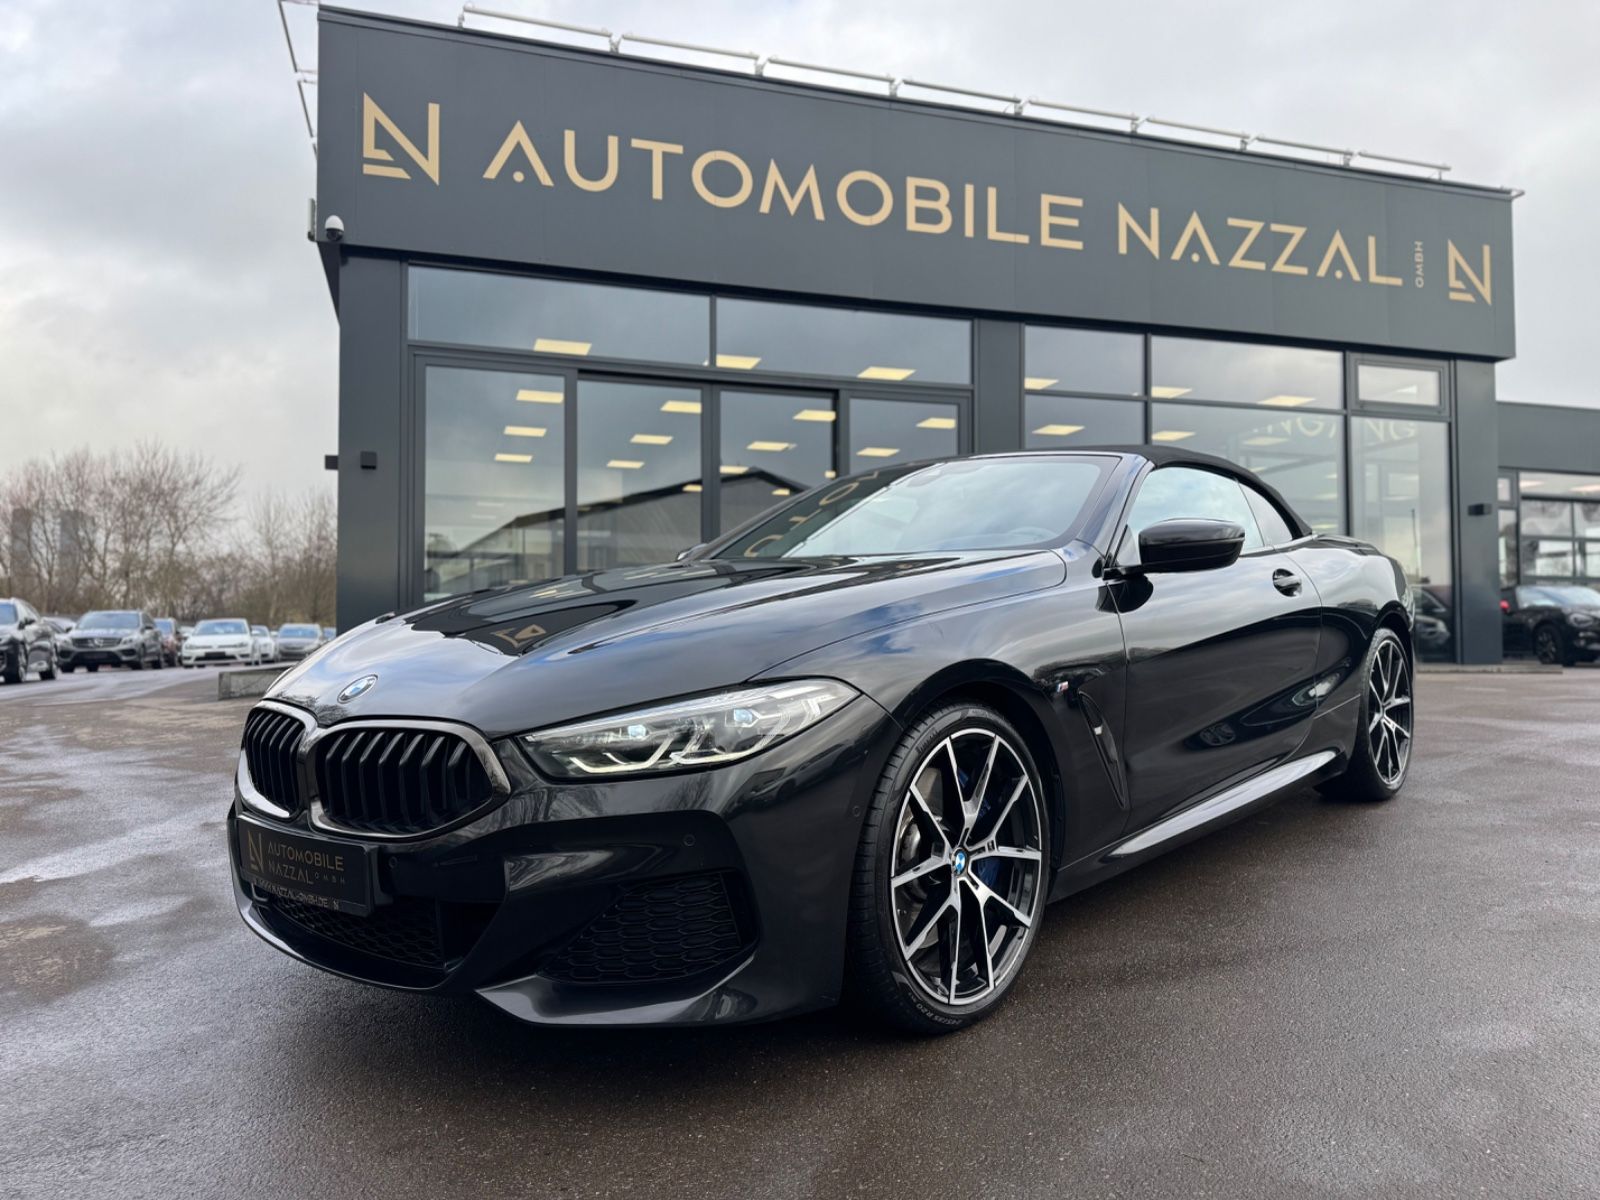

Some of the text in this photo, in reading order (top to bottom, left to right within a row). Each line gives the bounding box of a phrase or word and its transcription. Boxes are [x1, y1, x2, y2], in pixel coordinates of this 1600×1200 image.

[483, 120, 1085, 251] AUTOMOBILE
[1117, 202, 1403, 287] NAZZAL
[268, 841, 345, 872] AUTOMOBILE
[268, 859, 314, 885] NAZZAL
